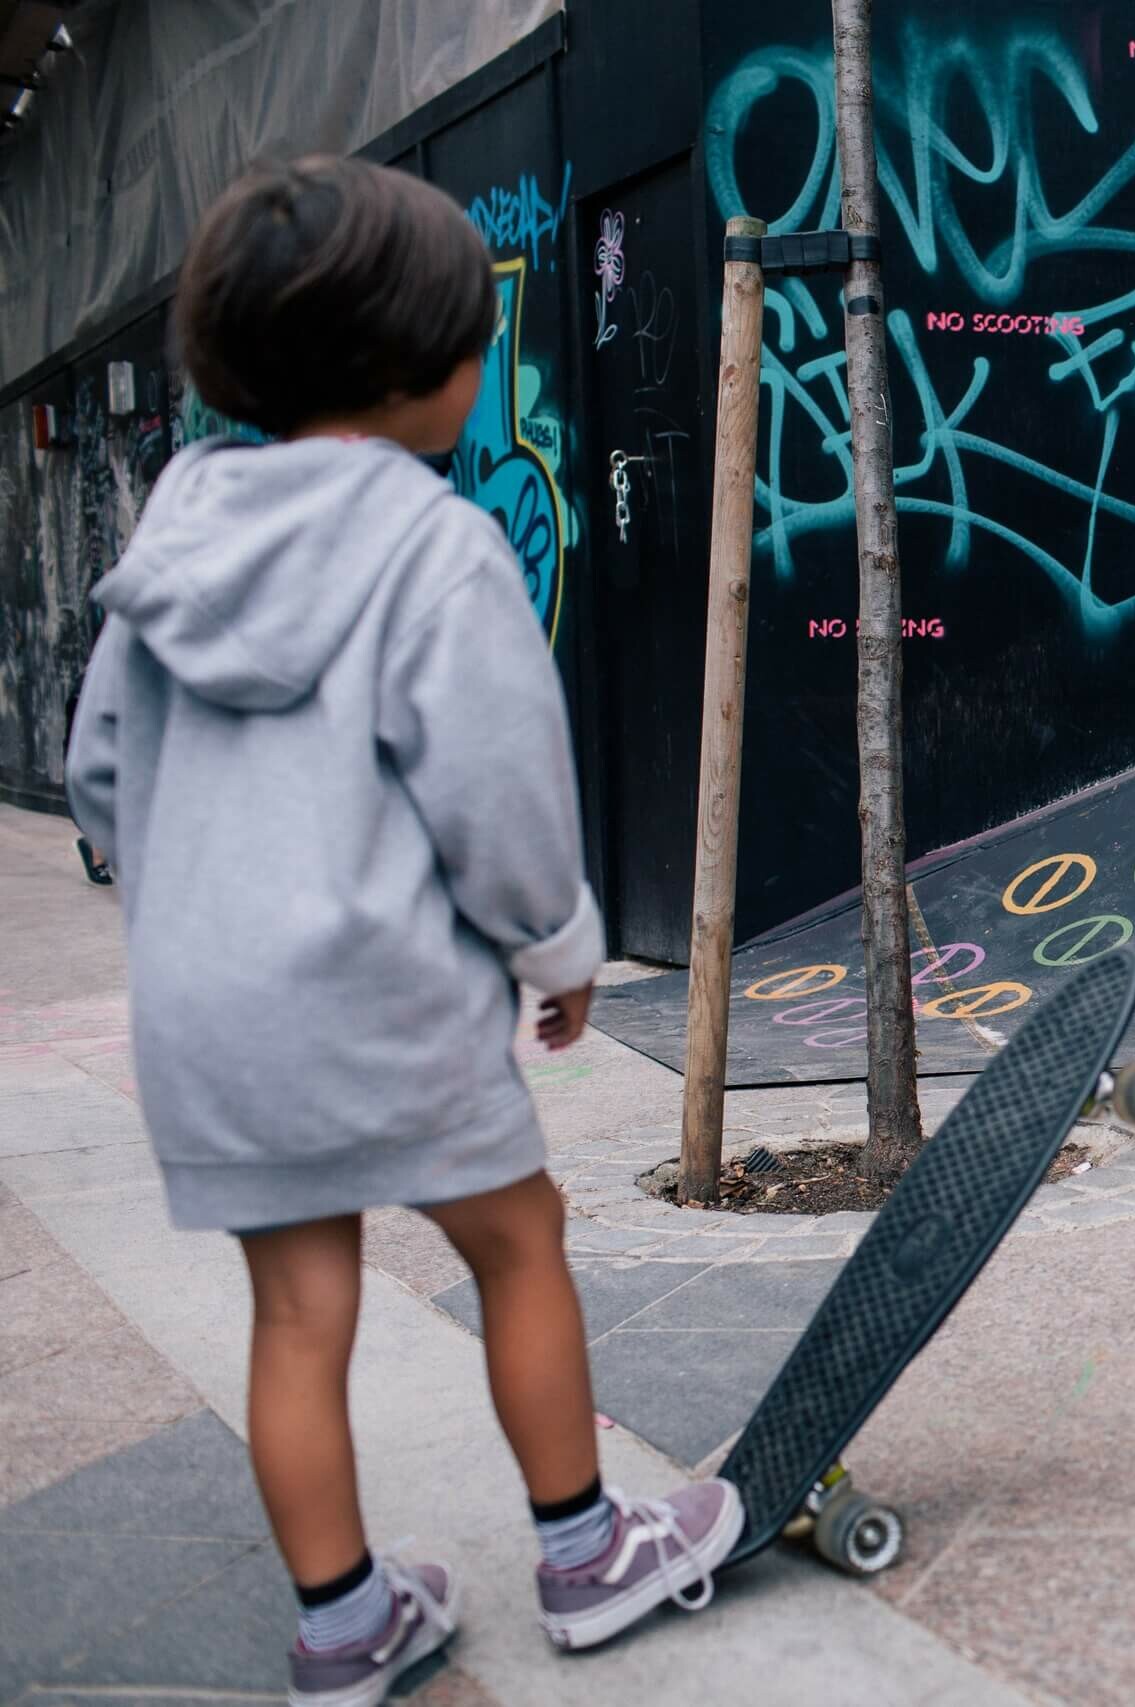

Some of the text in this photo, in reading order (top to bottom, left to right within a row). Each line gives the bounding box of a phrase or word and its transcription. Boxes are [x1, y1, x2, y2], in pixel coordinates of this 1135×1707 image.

[927, 311, 1085, 336] NO SCOOTING
[808, 619, 847, 638] NO
